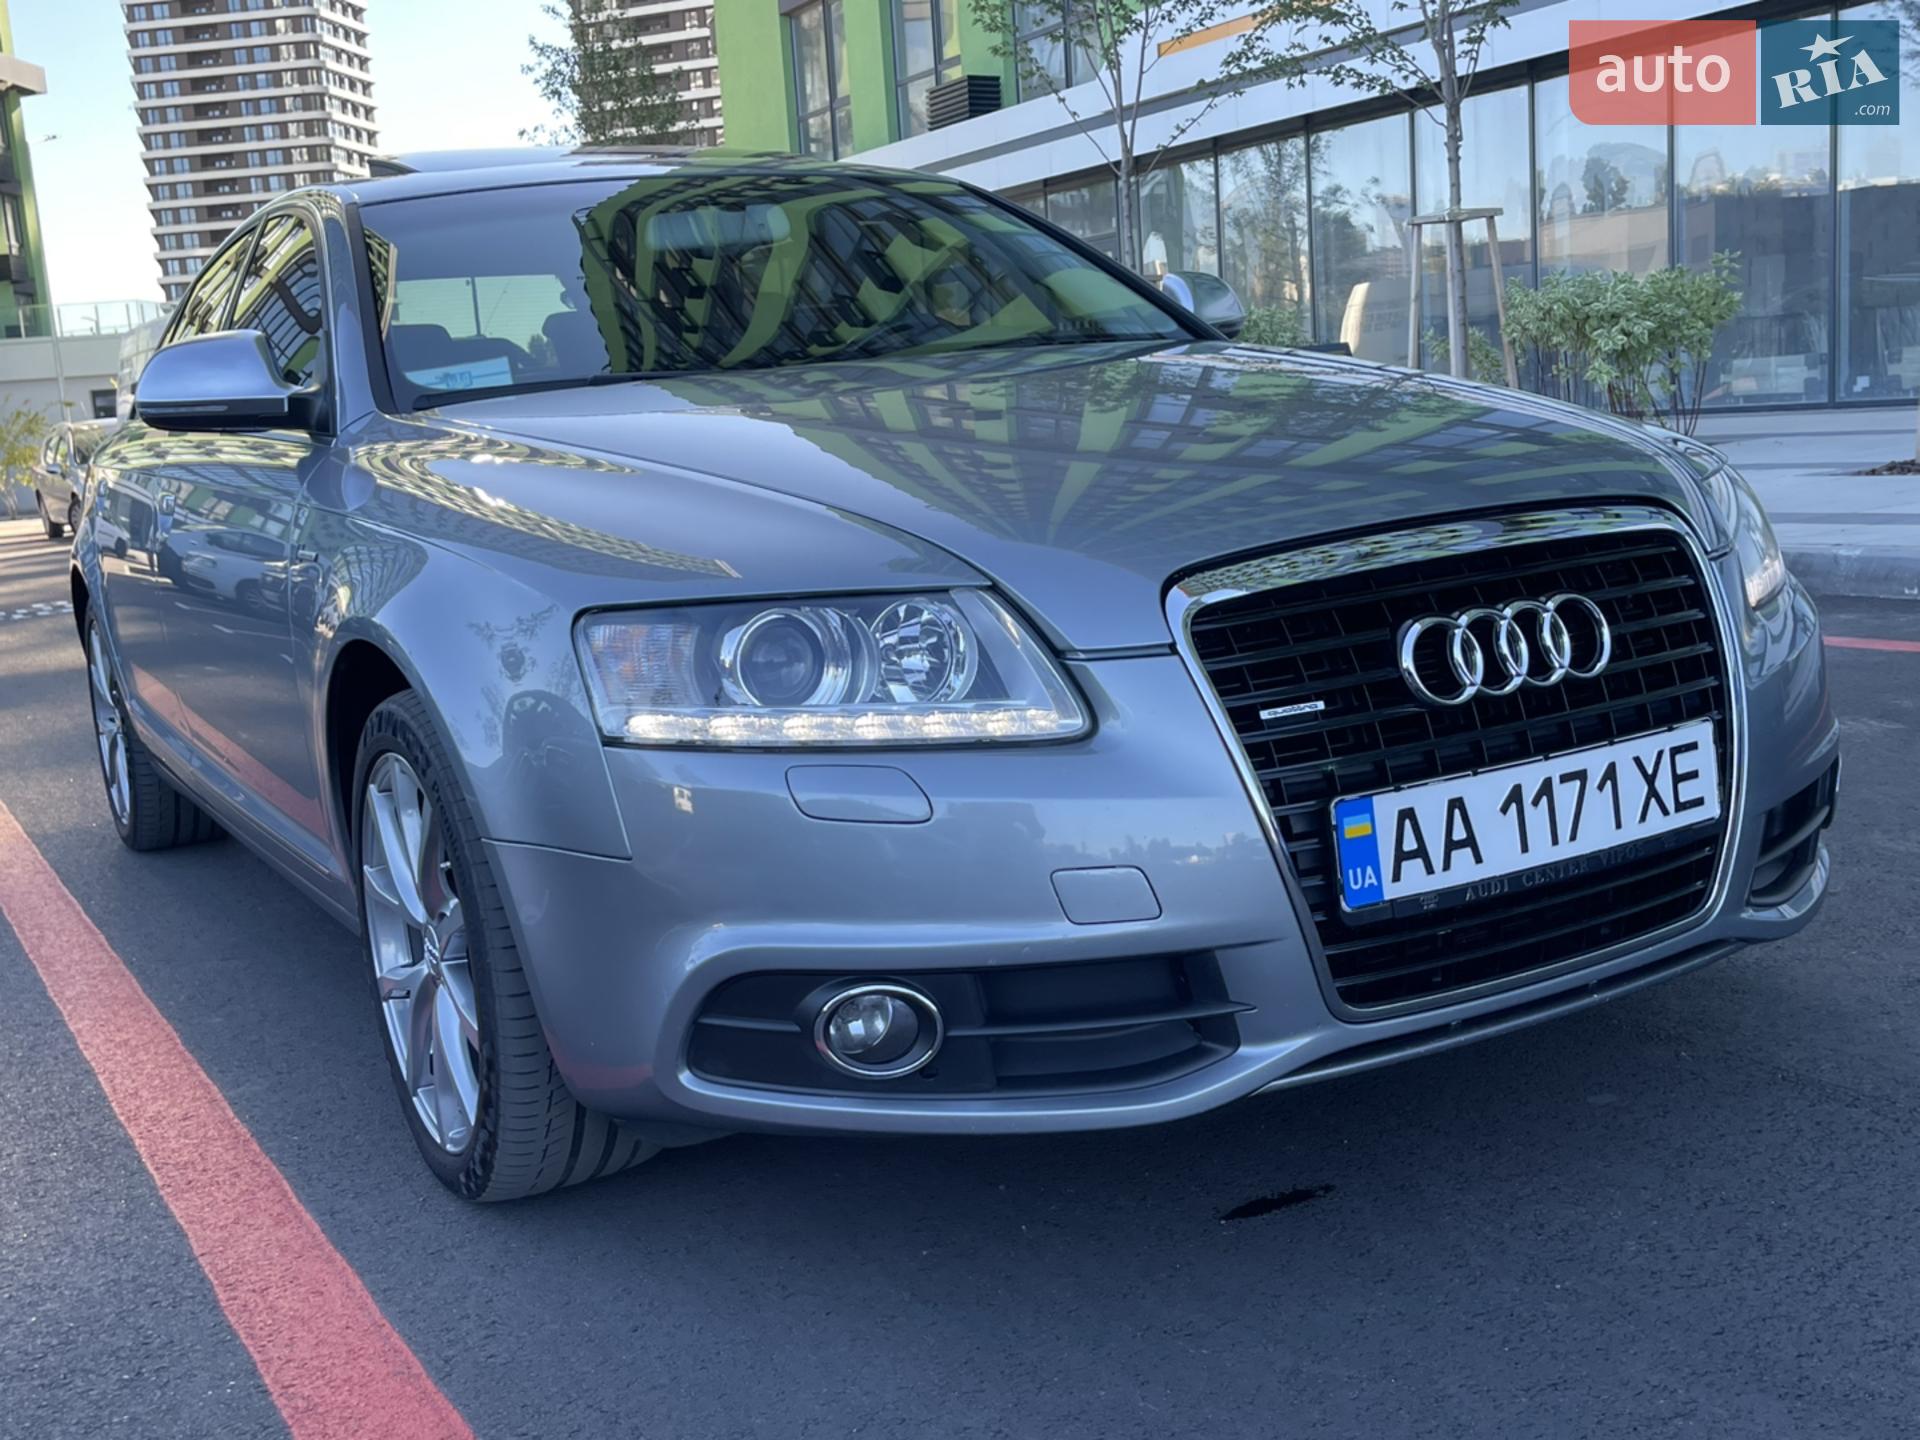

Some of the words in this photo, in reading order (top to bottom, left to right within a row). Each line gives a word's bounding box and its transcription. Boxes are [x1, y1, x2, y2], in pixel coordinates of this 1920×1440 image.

[1391, 796, 1484, 884] AA
[1499, 761, 1622, 854] 1171
[1632, 741, 1705, 824] XE
[1348, 864, 1378, 890] UA
[1465, 881, 1509, 902] AUDI
[1522, 860, 1590, 888] CENTER
[1600, 842, 1646, 867] VIPOS
